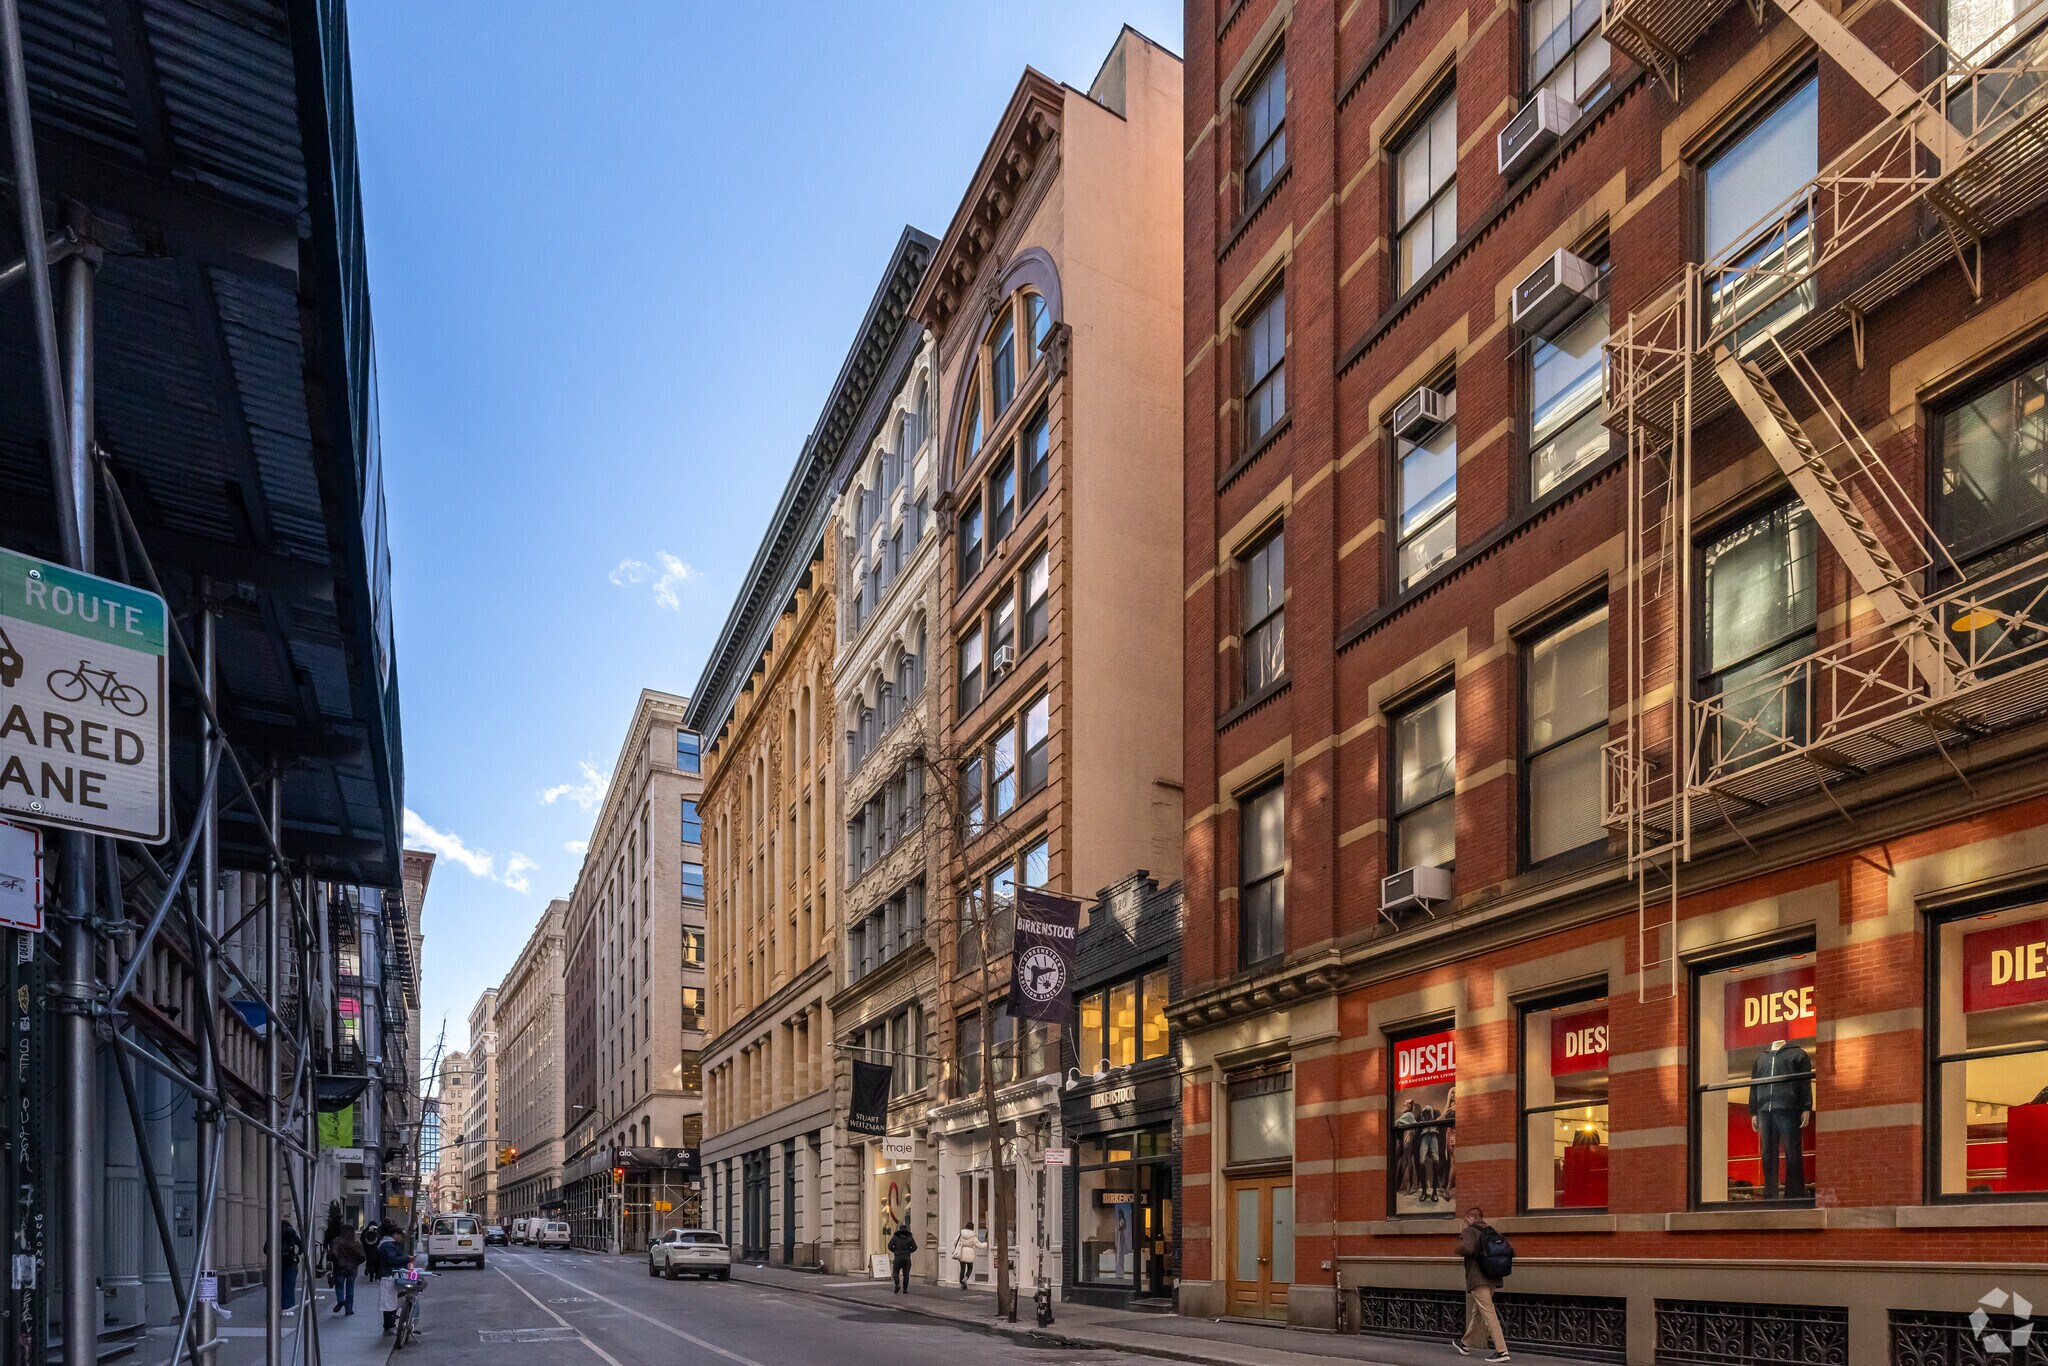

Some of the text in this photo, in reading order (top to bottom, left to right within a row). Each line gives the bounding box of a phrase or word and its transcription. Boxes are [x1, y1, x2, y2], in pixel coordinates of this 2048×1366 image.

[25, 577, 144, 636] ROUTE
[0, 704, 145, 766] ARED
[0, 755, 108, 810] ANE
[1016, 917, 1075, 939] BIRKENSTOCK
[1991, 942, 2048, 986] DIE
[1744, 986, 1814, 1028] DIESE
[1565, 1025, 1609, 1058] DIES
[1398, 1041, 1456, 1079] DIESEL
[1408, 1075, 1440, 1084] SUCCESSFUL
[1090, 1085, 1136, 1109] BIRKENSTOCK
[849, 1119, 886, 1132] WEITZMAN
[855, 1112, 880, 1124] STUART
[619, 1148, 690, 1159] alo alo
[886, 1143, 913, 1154] maje
